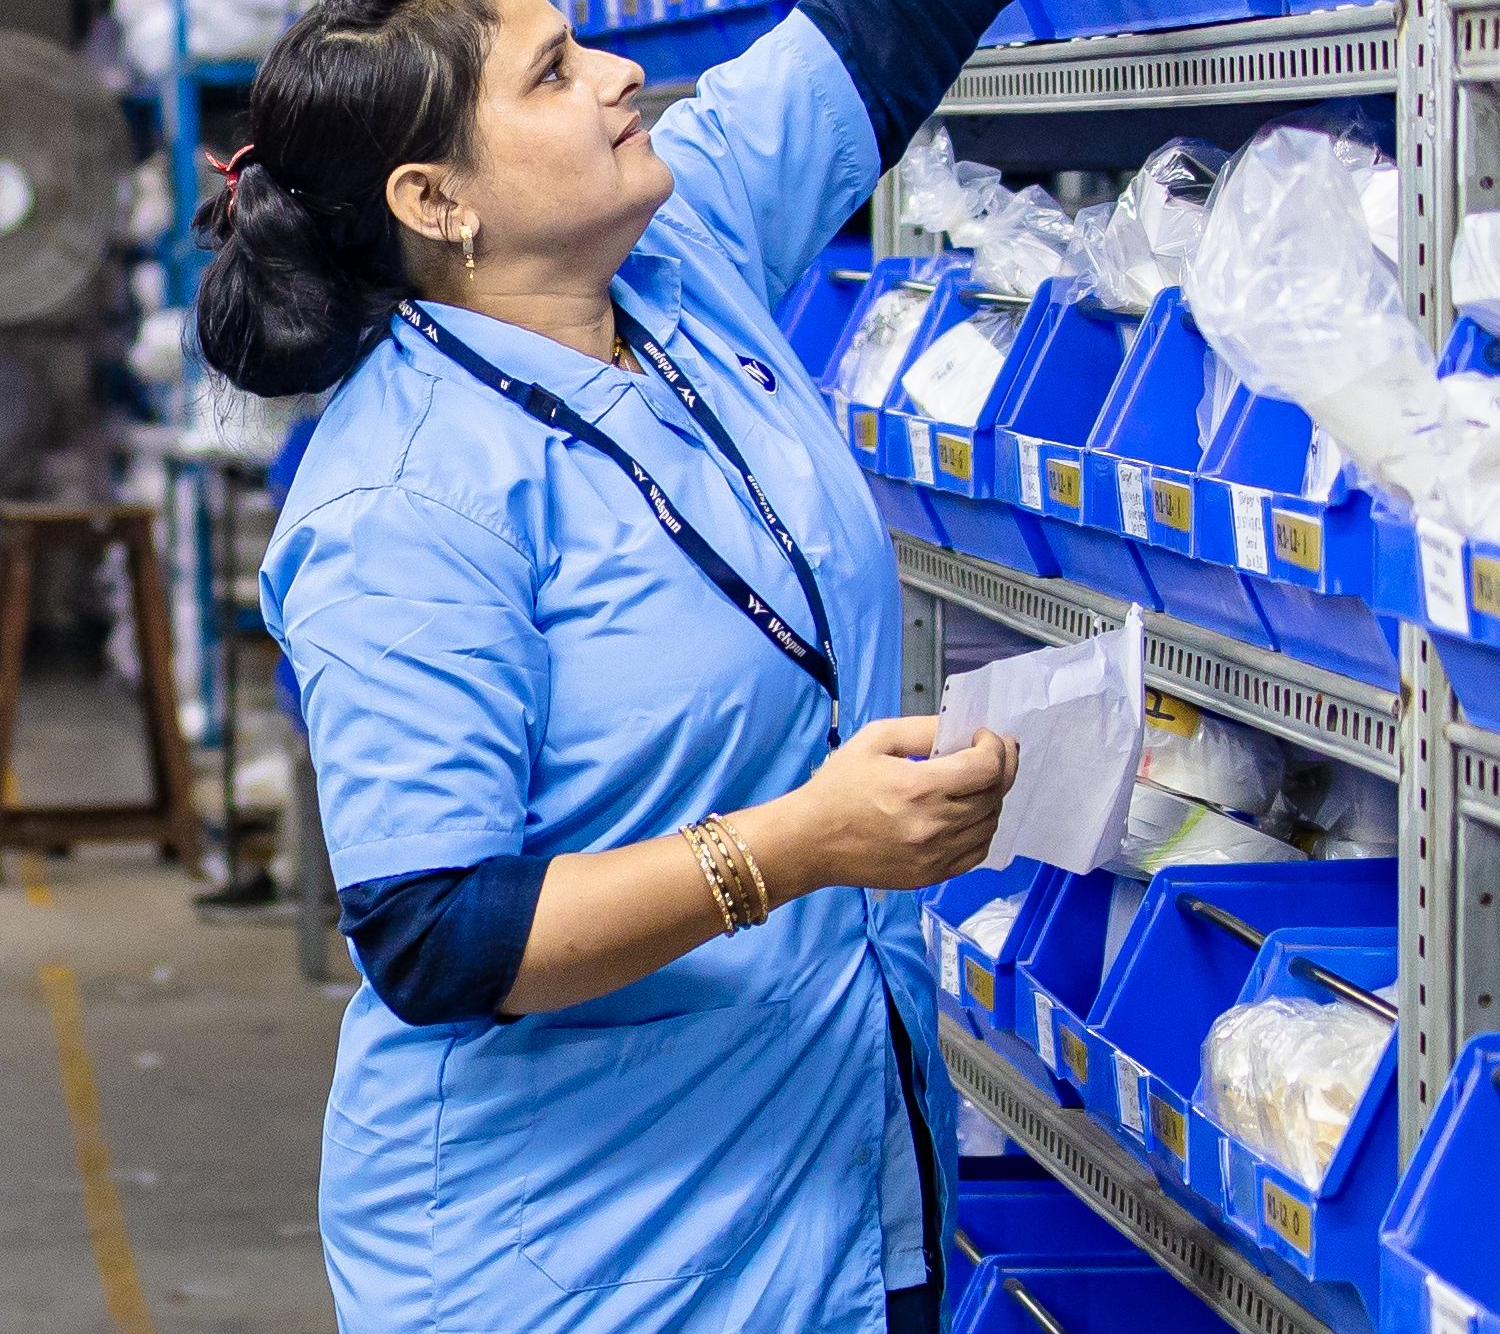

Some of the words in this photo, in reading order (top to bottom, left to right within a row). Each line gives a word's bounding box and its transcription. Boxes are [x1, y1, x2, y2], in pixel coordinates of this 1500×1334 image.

[643, 341, 679, 384] Welspun
[649, 484, 683, 534] Welspun
[747, 474, 777, 525] Welspun
[767, 616, 806, 658] Welspun
